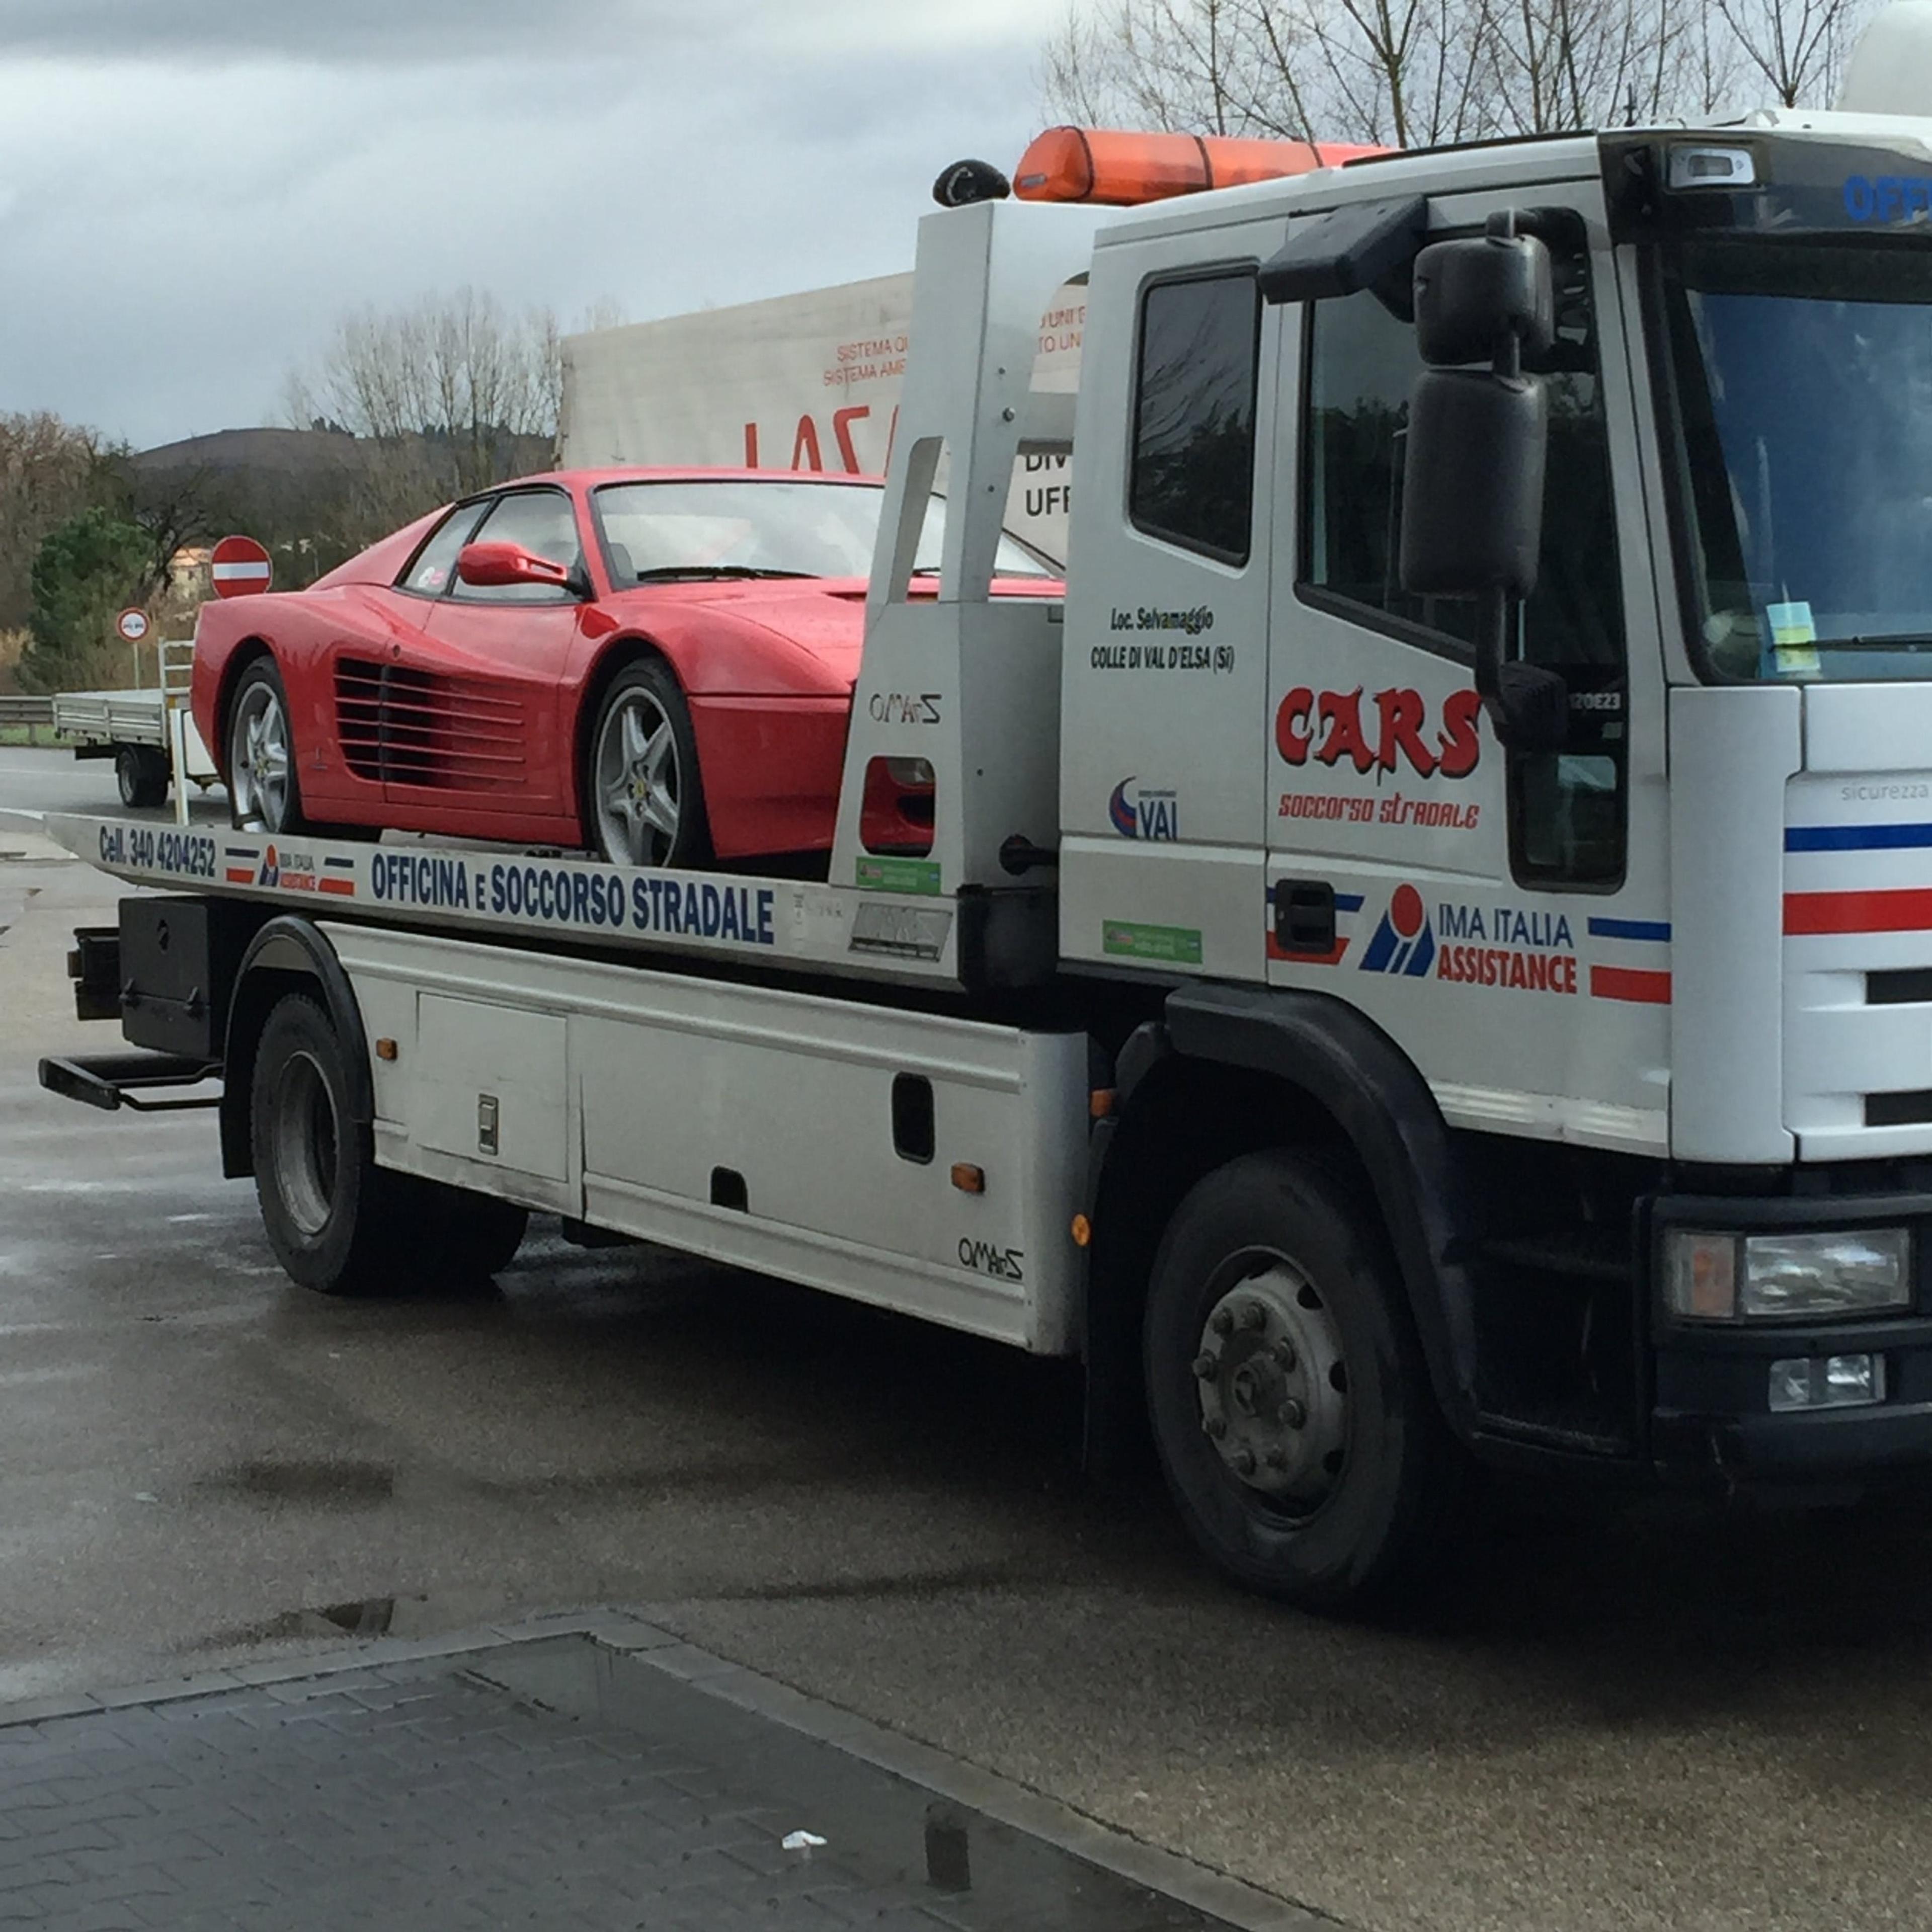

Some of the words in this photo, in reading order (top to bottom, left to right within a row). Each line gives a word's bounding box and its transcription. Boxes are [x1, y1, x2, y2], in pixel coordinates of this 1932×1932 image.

[837, 339, 892, 361] SISTEMA
[824, 365, 876, 386] SISTEMA
[1111, 607, 1134, 630] Loc.
[1136, 605, 1214, 635] Selvamaggio
[1090, 646, 1126, 669] COLLE
[1129, 646, 1142, 669] DI
[1144, 646, 1165, 669] VAL
[1168, 646, 1211, 670] D'ELSA
[1276, 686, 1482, 786] CARS
[1841, 784, 1929, 801] sicurezza
[1139, 800, 1177, 841] VAI
[100, 826, 126, 864] Cell.
[130, 828, 154, 868] 340
[157, 832, 215, 877] 4204252
[372, 854, 469, 909] OFFICINA
[475, 873, 486, 911] E
[491, 864, 625, 927] SOCCORSO
[632, 877, 774, 944] STRADALE
[1439, 903, 1486, 940] IMA
[1494, 908, 1574, 949] ITALIA
[1437, 943, 1577, 995] ASSISTANCE
